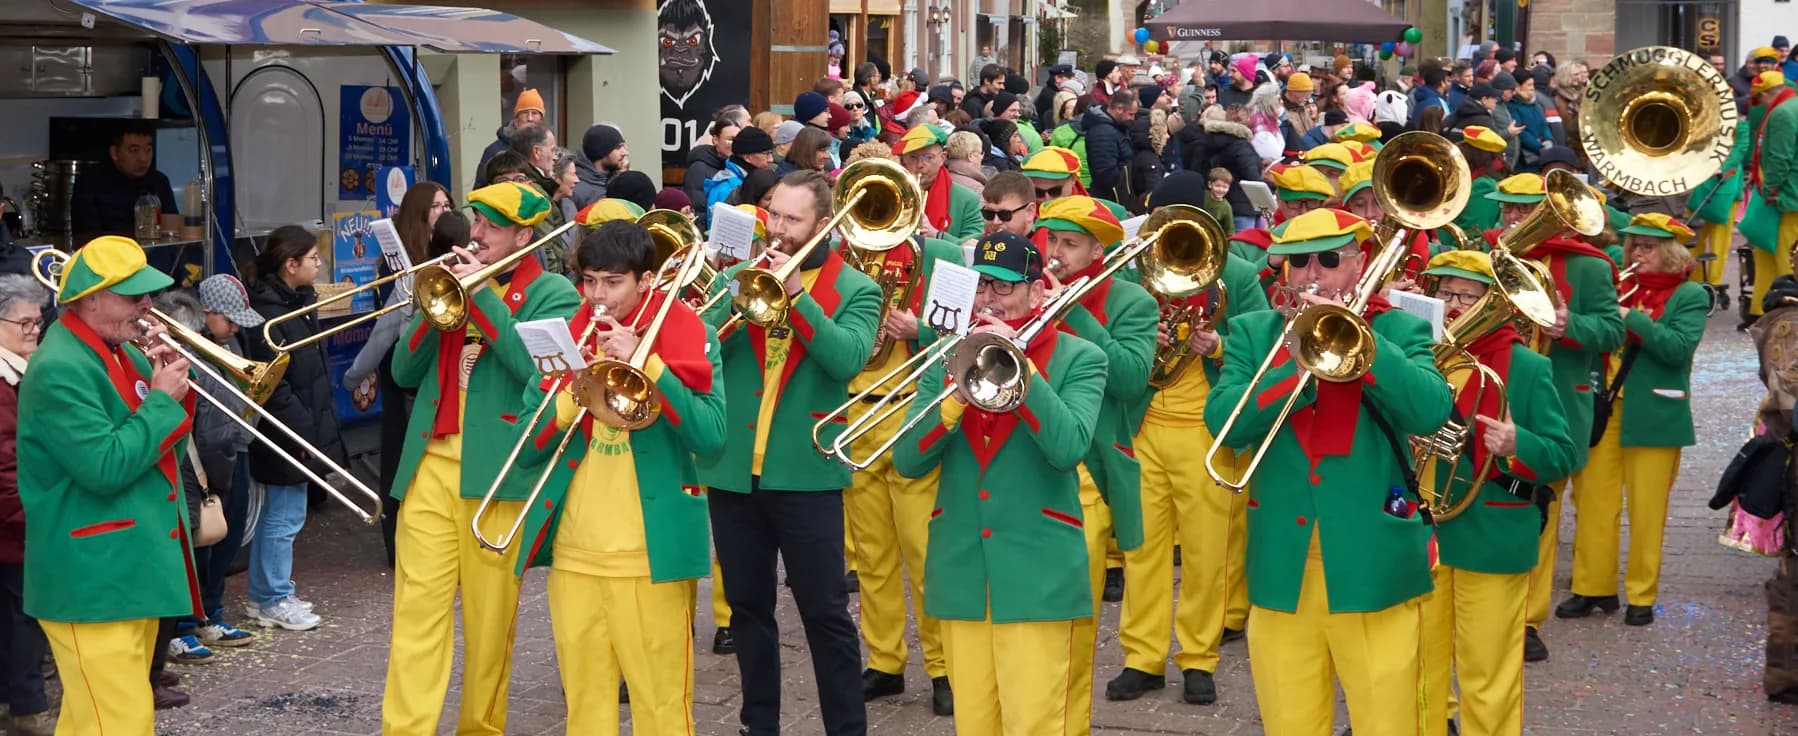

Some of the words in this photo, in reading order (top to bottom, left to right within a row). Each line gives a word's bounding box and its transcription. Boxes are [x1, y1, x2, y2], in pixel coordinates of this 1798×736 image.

[1177, 28, 1222, 37] GUINNESS
[356, 122, 393, 136] Menü
[1583, 132, 1688, 195] WARMBACH
